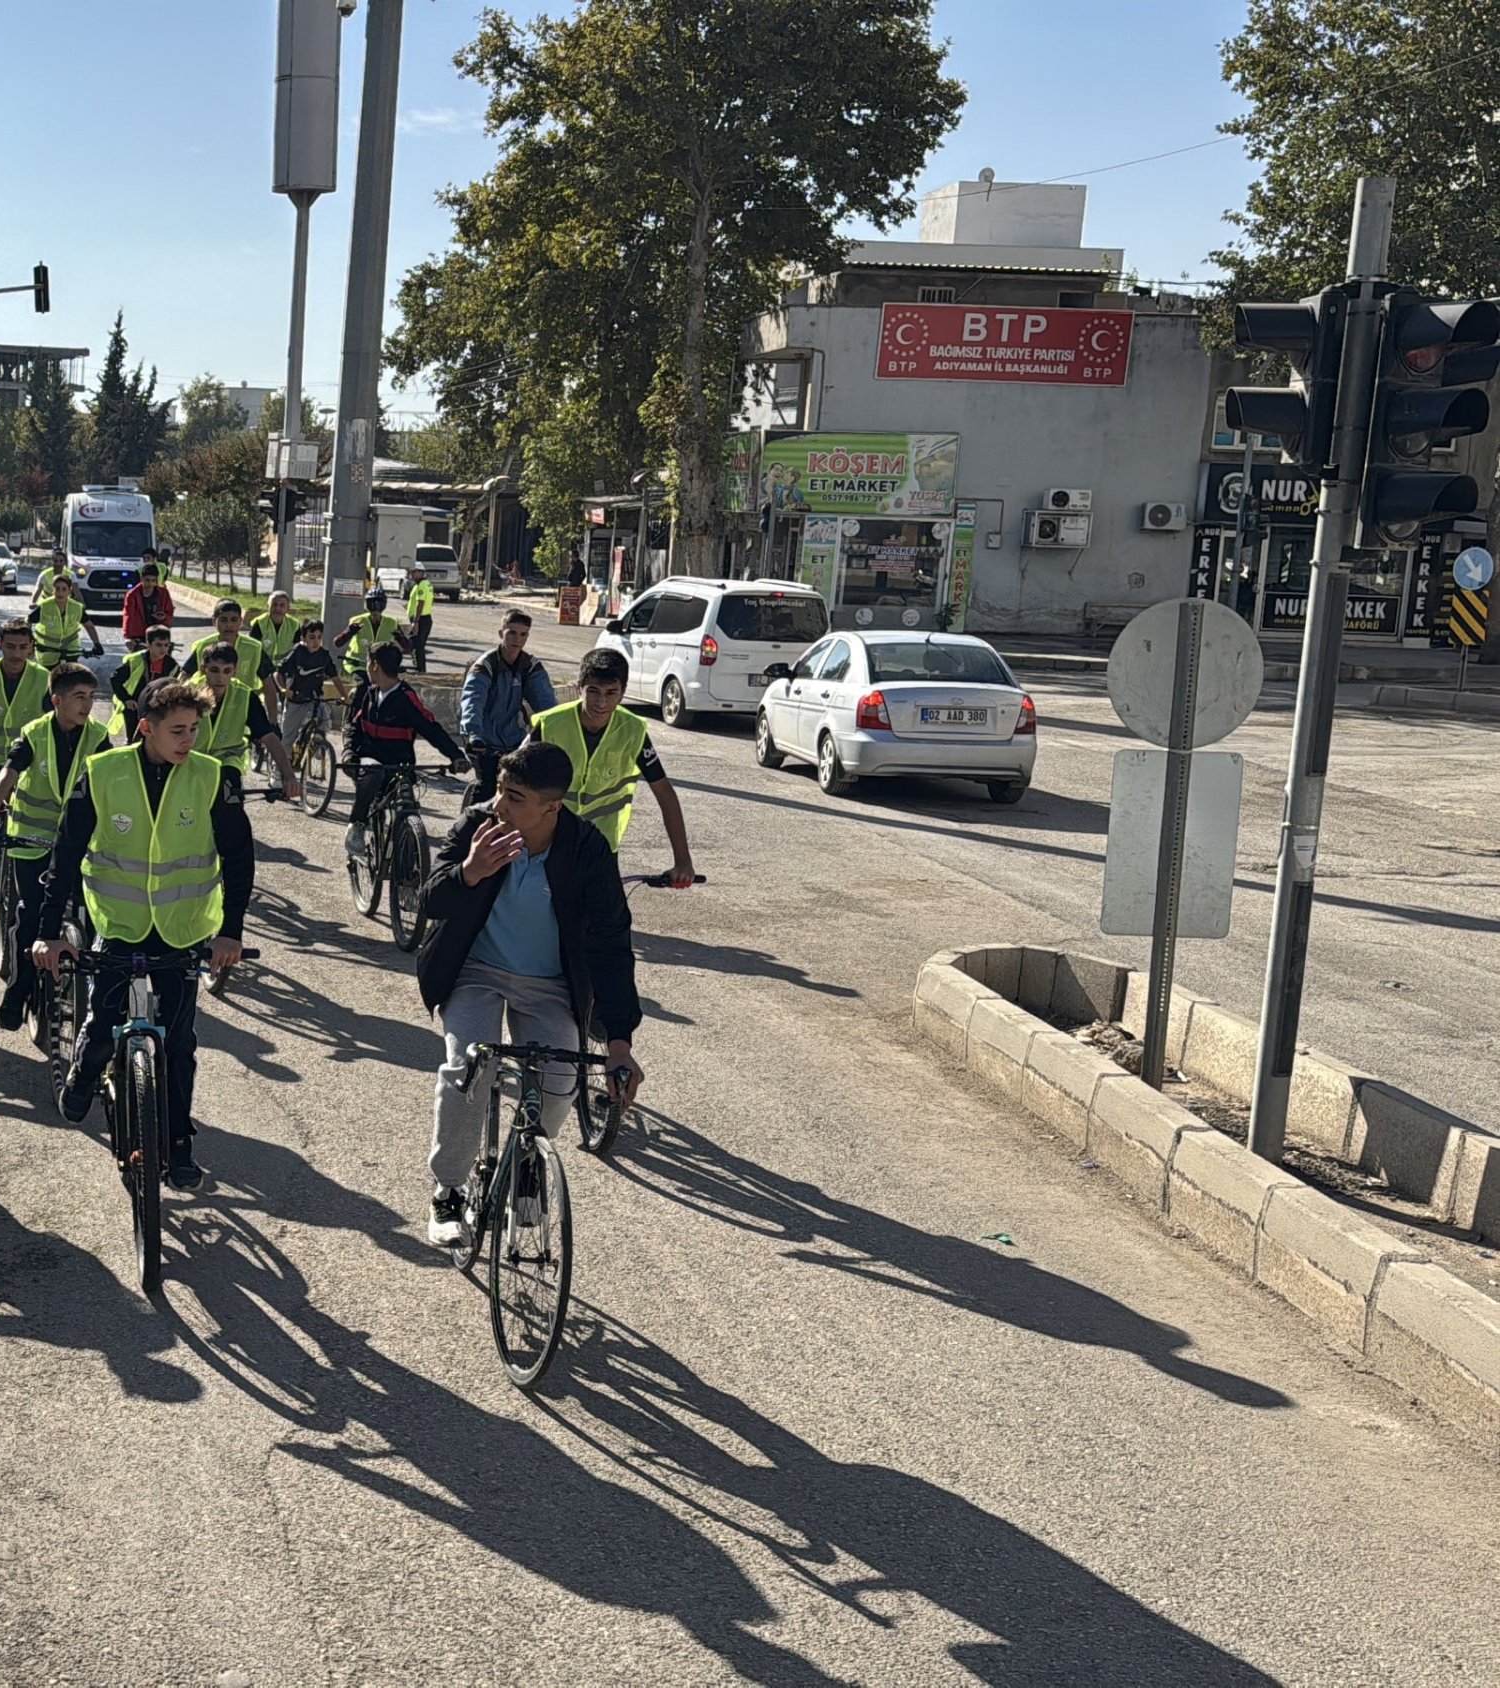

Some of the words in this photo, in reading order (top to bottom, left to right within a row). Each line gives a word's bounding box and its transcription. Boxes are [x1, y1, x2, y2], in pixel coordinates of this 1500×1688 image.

[963, 312, 1047, 343] BTP
[888, 361, 917, 372] BTP
[933, 361, 992, 372] ADIYAMAN
[994, 360, 1004, 372] İL
[1005, 362, 1068, 375] BAŞKANLIĞI
[1083, 367, 1112, 378] BTP
[808, 447, 906, 478] KÖŞEM
[809, 478, 828, 491] ET
[832, 479, 899, 493] MARKET
[1261, 479, 1308, 502] NUR
[812, 555, 826, 564] ET
[956, 549, 967, 557] ET
[1196, 538, 1212, 598] ERKE
[1412, 546, 1431, 627] ERKEK
[928, 710, 940, 721] 02
[947, 710, 964, 721] AAD
[967, 711, 985, 722] 380
